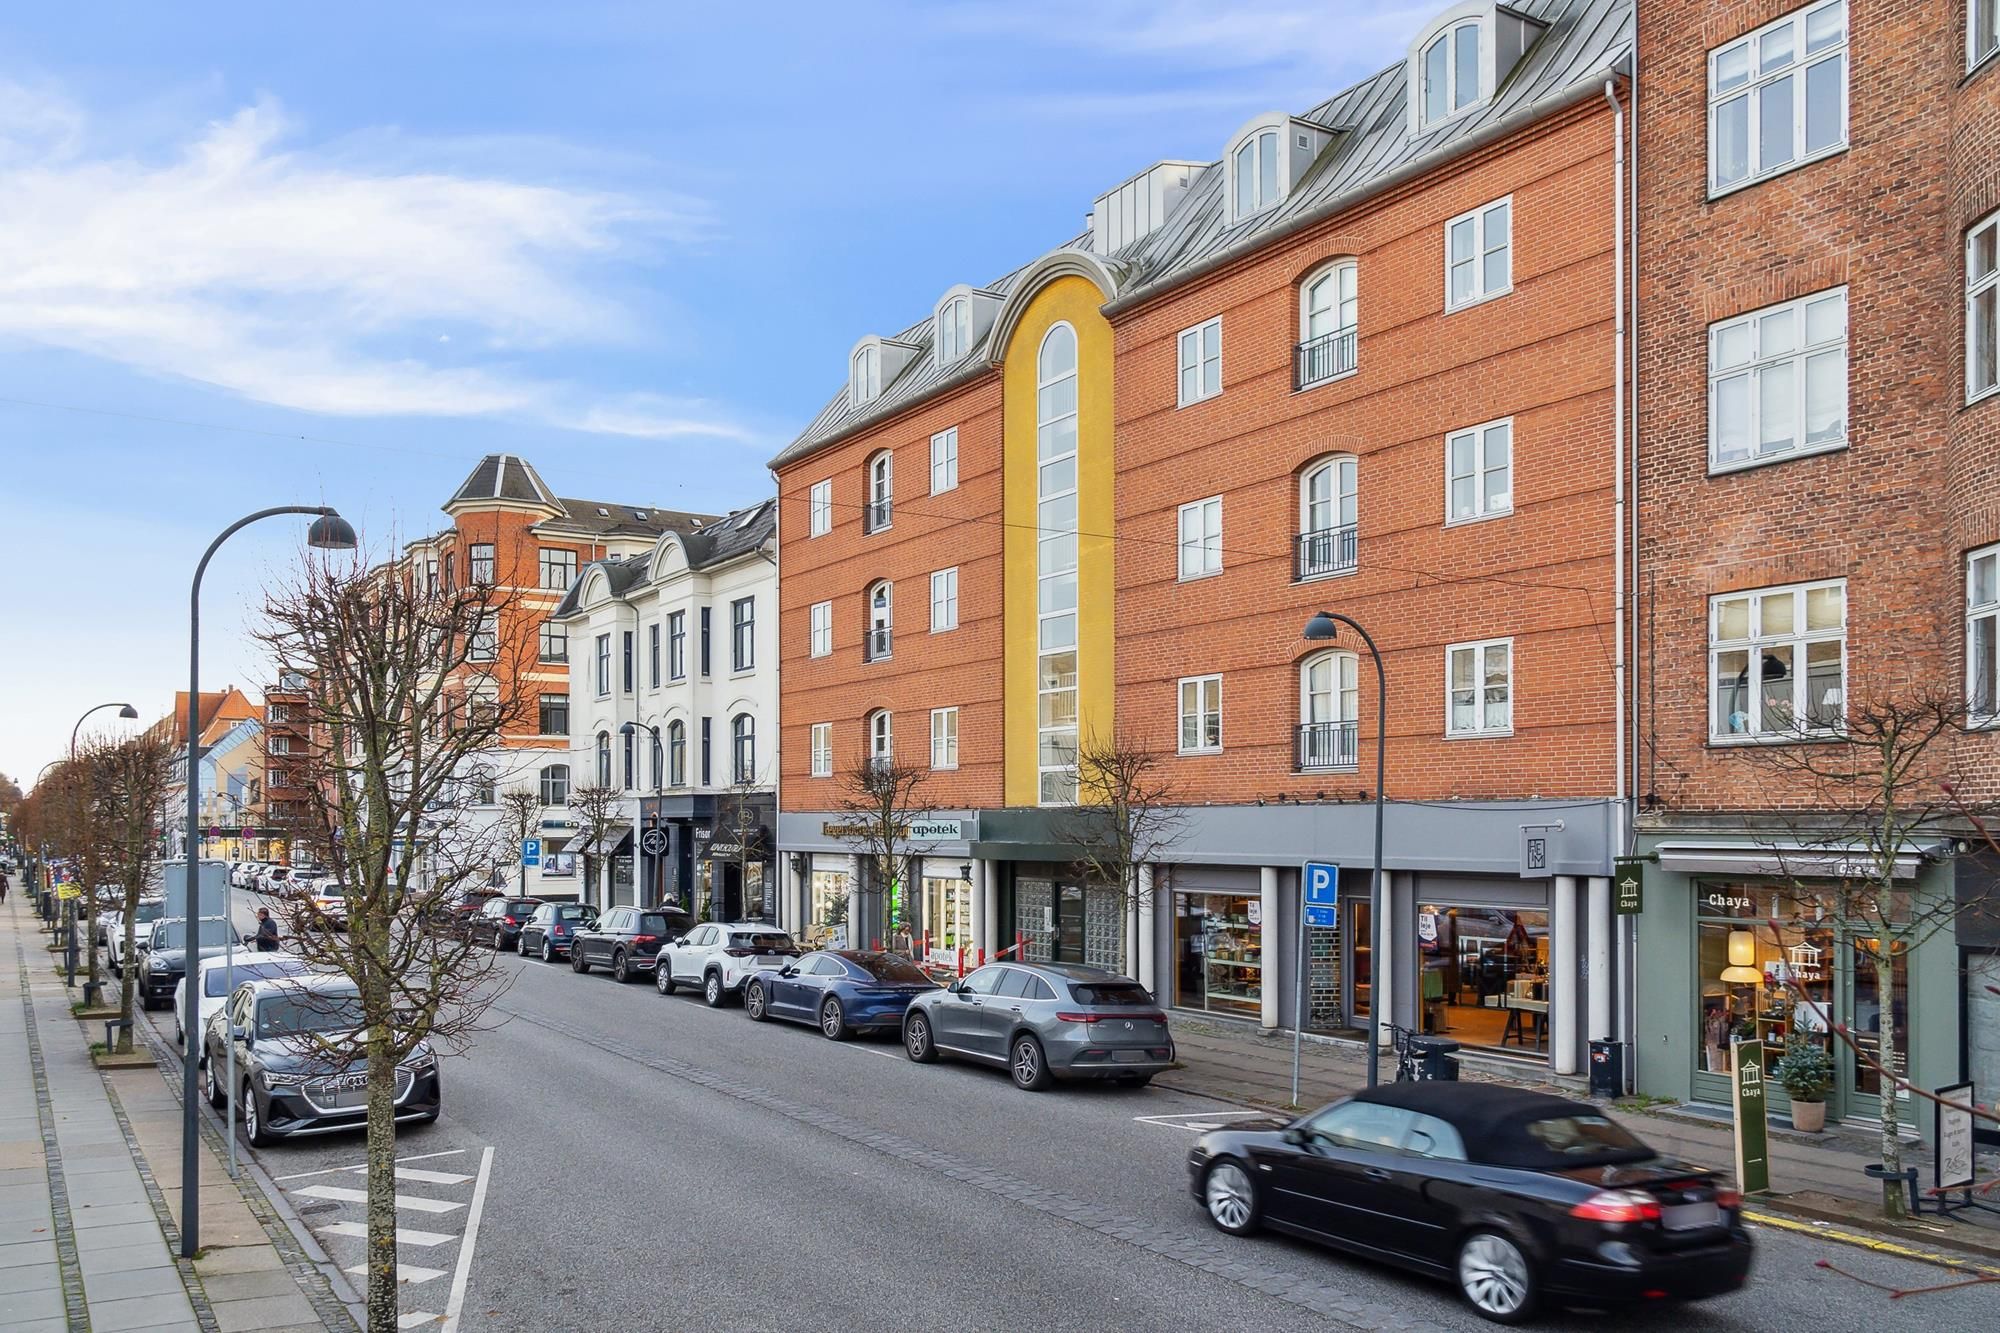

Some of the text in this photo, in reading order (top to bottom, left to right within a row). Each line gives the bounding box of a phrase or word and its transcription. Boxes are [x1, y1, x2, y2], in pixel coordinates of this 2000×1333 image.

[912, 822, 959, 837] apotek
[526, 841, 536, 854] P
[1312, 869, 1330, 899] P
[1620, 900, 1638, 909] Chaya
[1709, 893, 1750, 910] Chaya
[1742, 1087, 1761, 1097] Chaya
